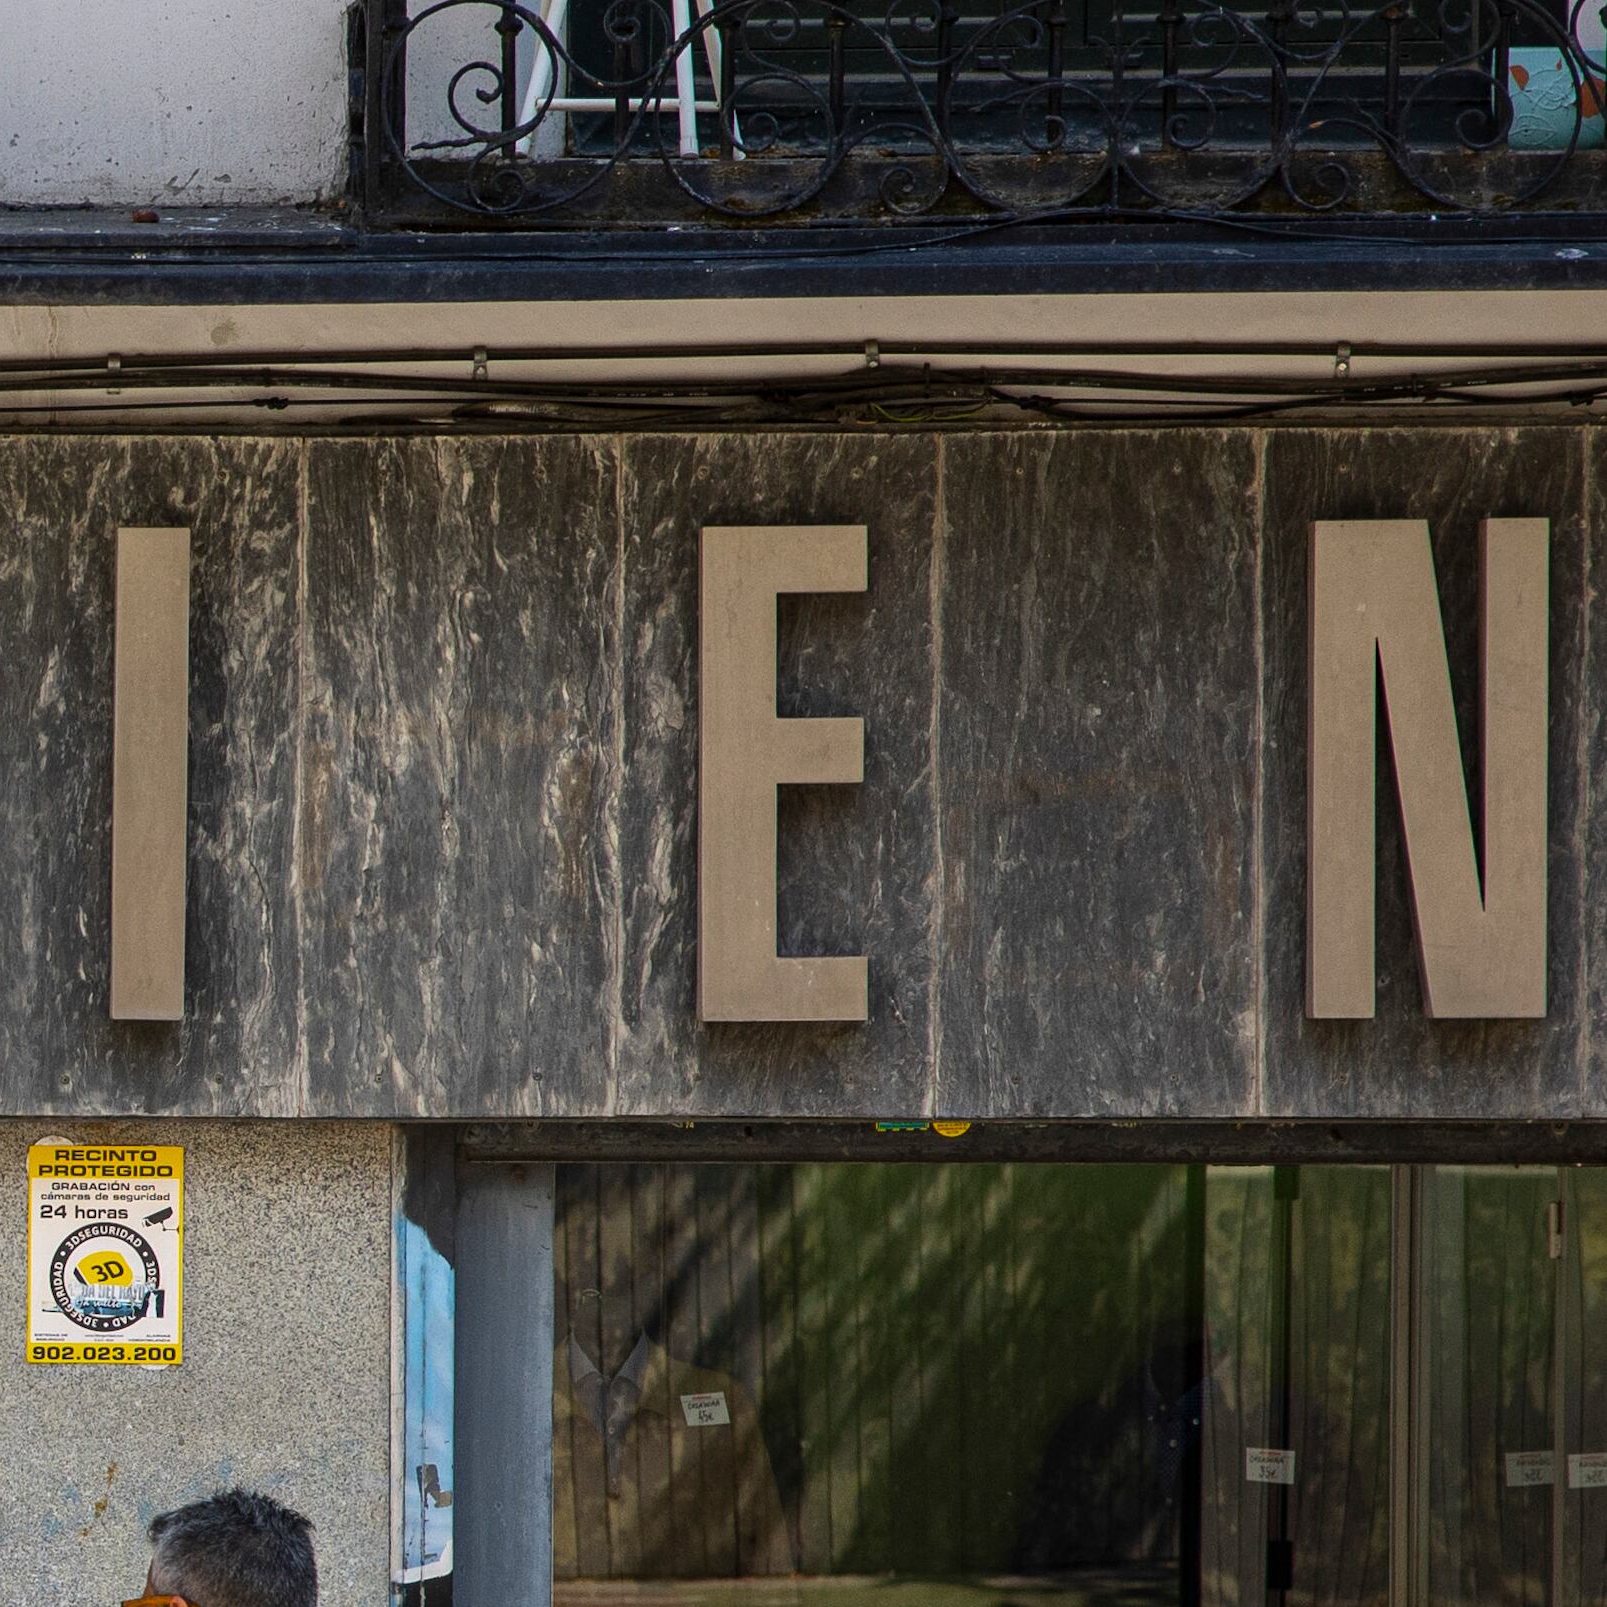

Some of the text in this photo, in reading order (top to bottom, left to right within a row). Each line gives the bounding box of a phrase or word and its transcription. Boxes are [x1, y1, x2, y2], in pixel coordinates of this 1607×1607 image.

[55, 1149, 157, 1162] RECINTO
[38, 1164, 174, 1177] PROTEGIDO
[51, 1181, 130, 1191] GRABACIÓN
[40, 1192, 171, 1203] cámaras de seguridad
[40, 1205, 129, 1219] 24 horas
[65, 1225, 143, 1250] 3DSEGURIDAD
[91, 1260, 125, 1283] 3D
[32, 1345, 176, 1361] 902.023.200
